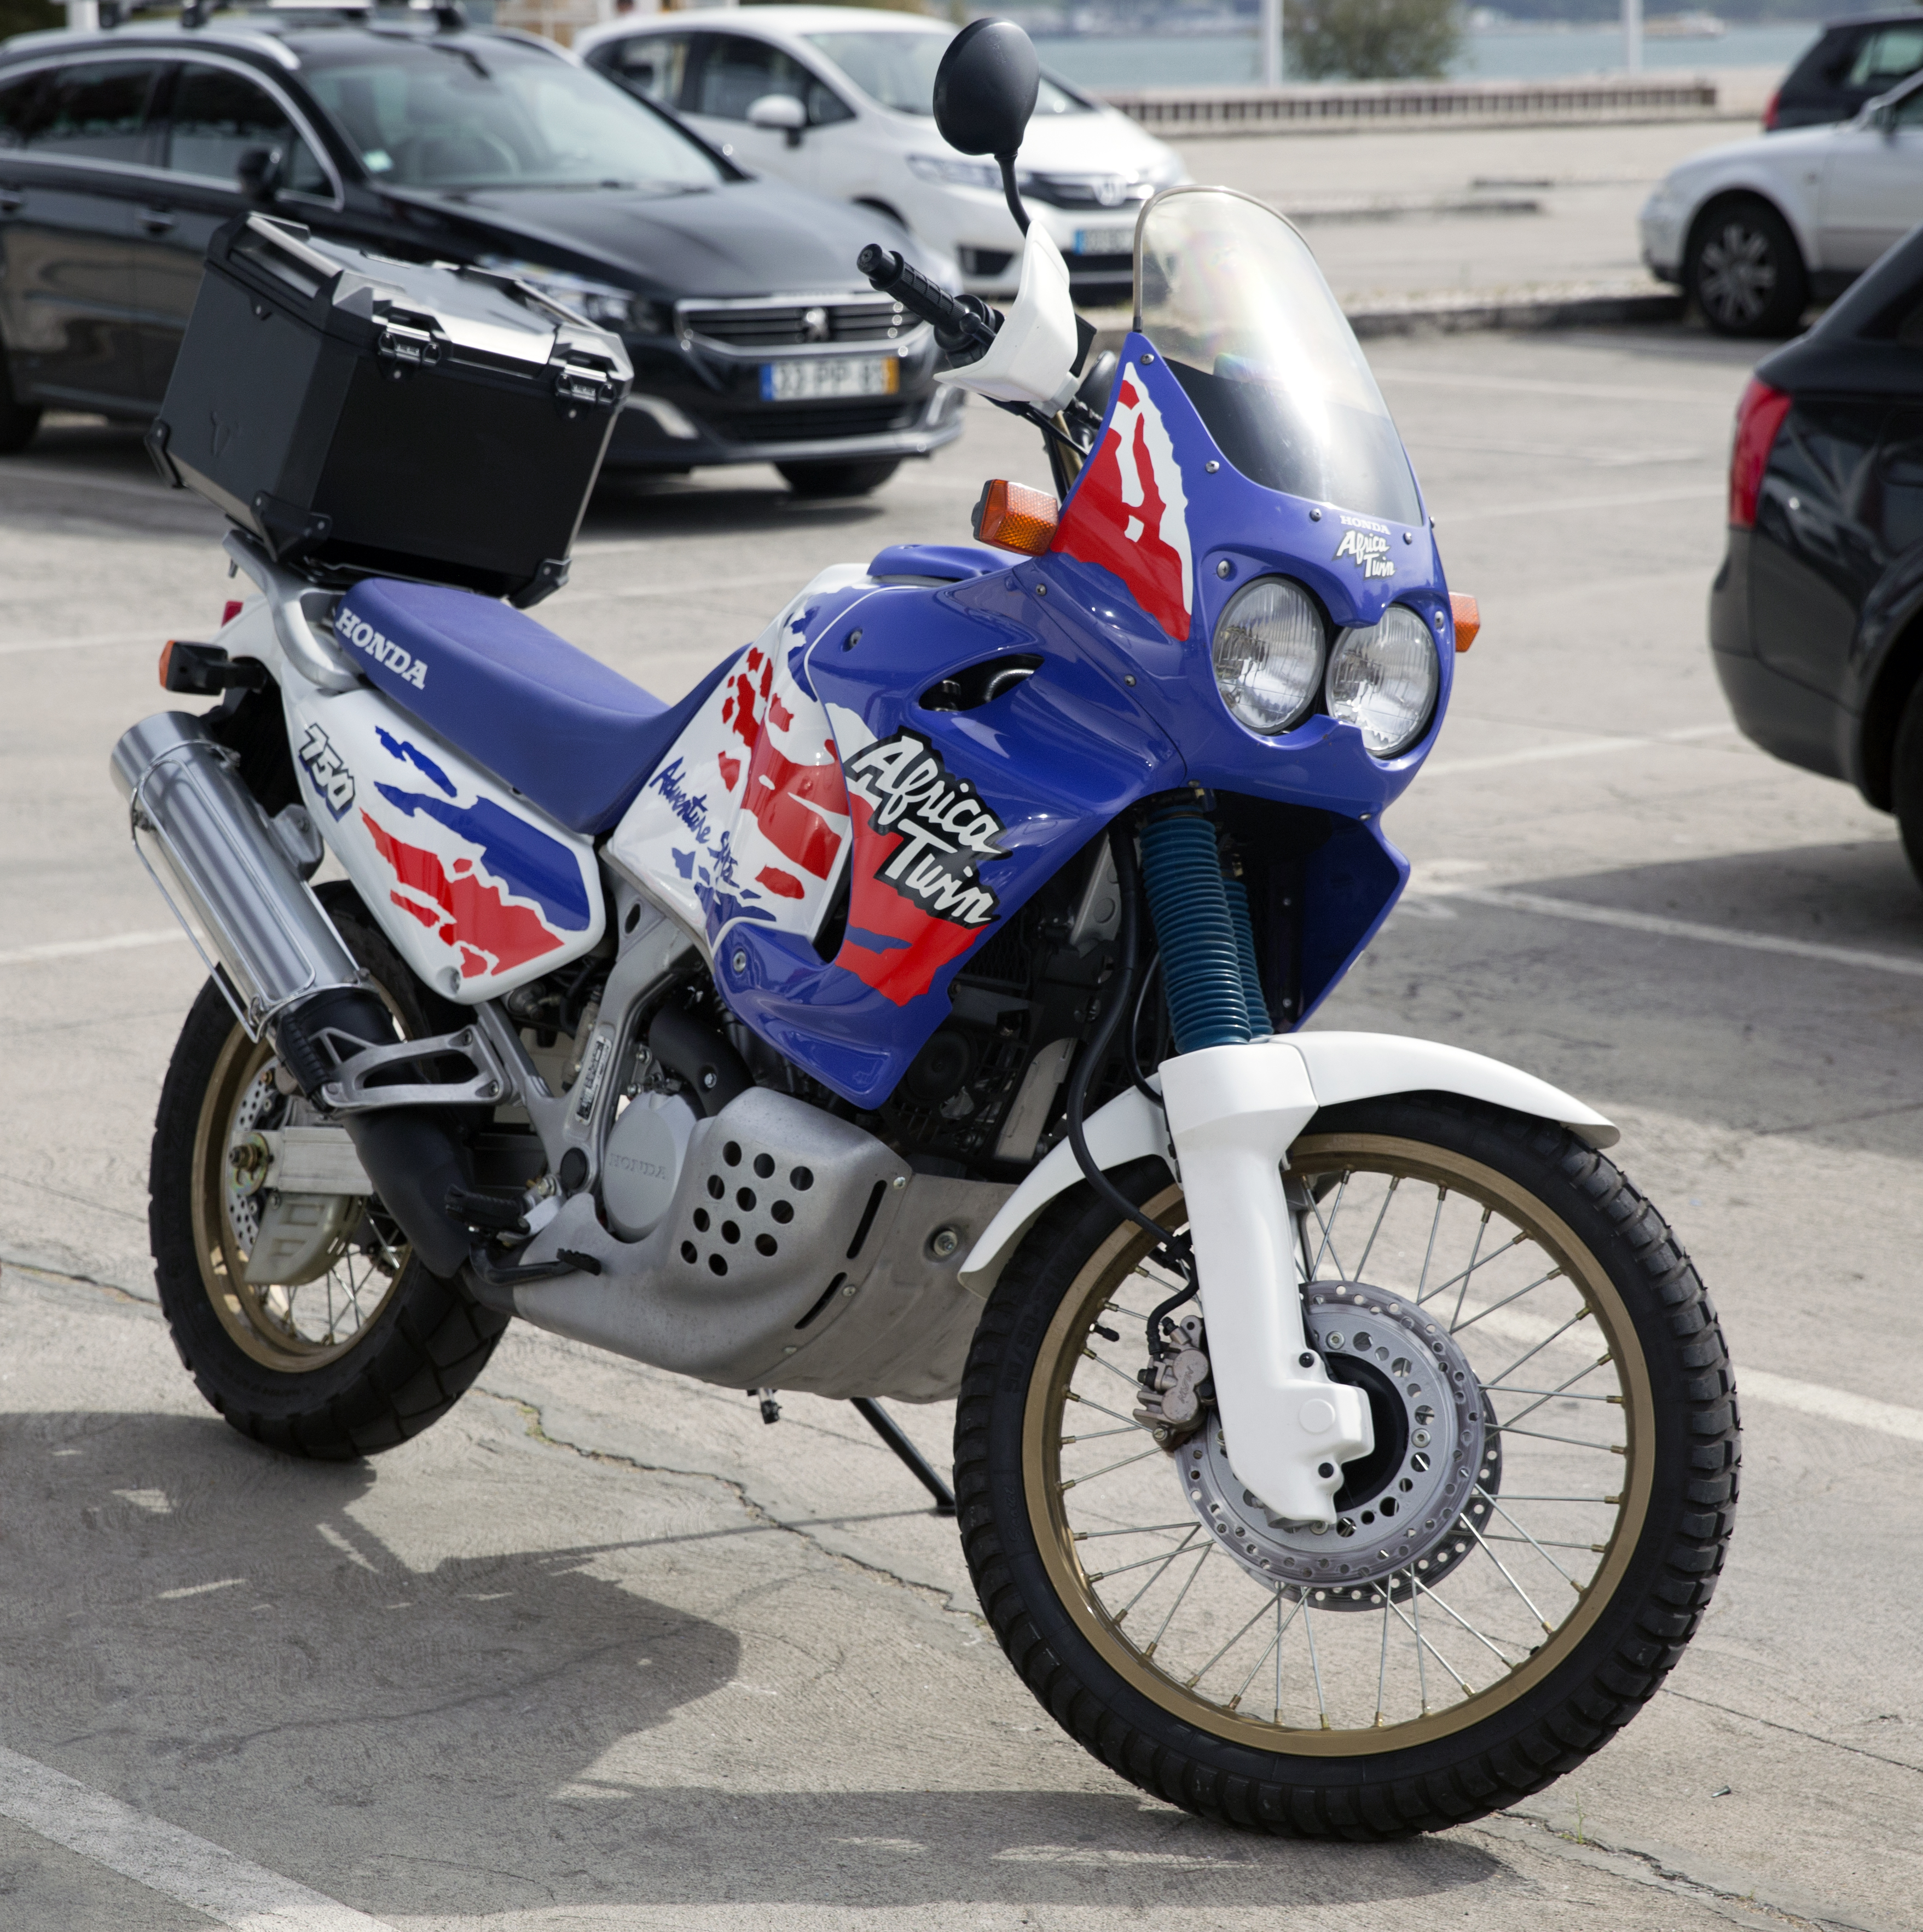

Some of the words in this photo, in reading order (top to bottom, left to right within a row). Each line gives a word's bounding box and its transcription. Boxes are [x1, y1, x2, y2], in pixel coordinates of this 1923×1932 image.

[1336, 530, 1391, 565] Africa
[1339, 515, 1391, 535] HONDA
[1363, 553, 1396, 578] Twin
[335, 607, 428, 690] HONDA
[299, 722, 356, 812] 750
[648, 756, 711, 844] Adventure
[849, 733, 1003, 855] Africa
[884, 818, 992, 924] Twin
[609, 1152, 667, 1180] HONDA
